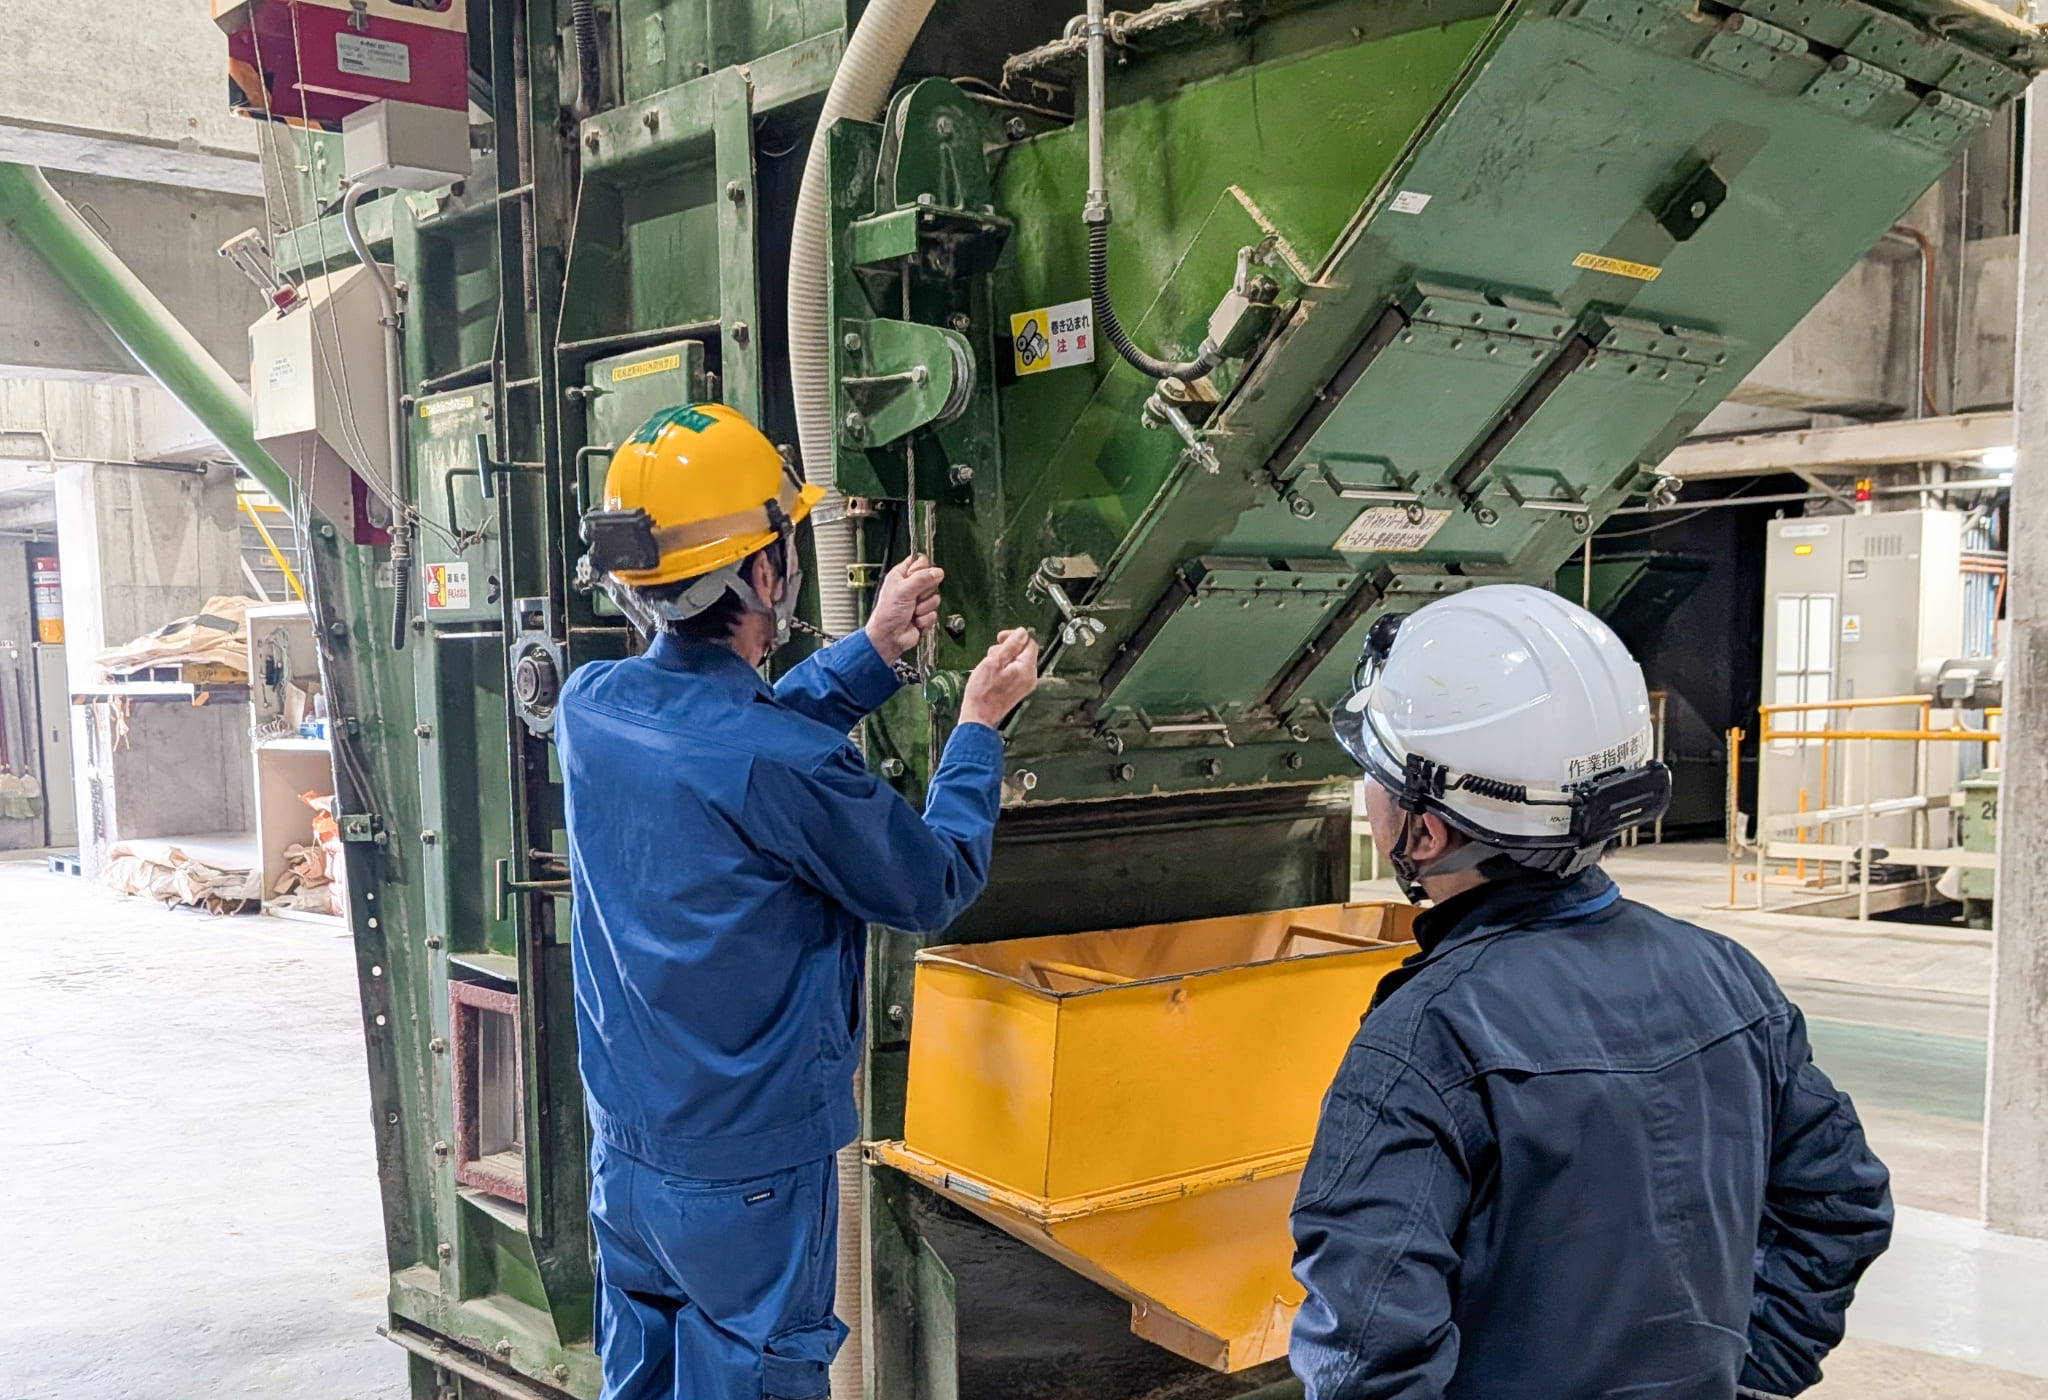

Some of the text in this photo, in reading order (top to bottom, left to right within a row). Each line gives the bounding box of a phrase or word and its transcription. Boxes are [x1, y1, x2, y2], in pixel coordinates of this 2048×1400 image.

[1050, 315, 1090, 335] 巻き込まれ
